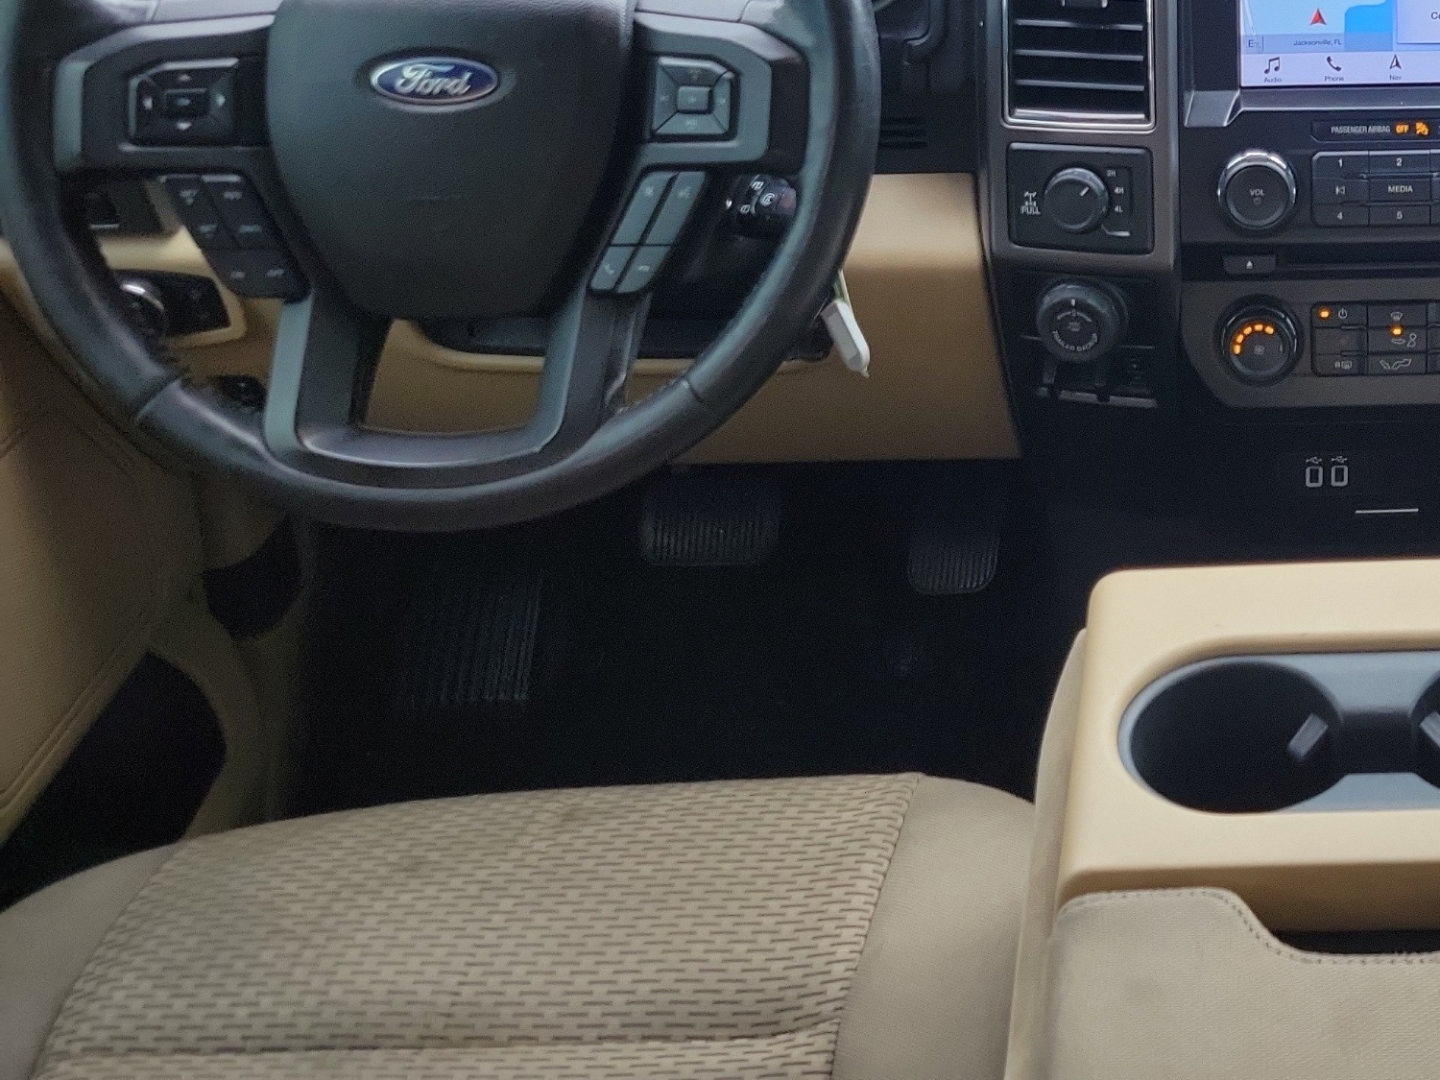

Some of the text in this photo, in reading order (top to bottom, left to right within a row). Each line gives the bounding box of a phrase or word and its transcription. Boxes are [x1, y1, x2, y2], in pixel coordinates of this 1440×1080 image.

[395, 63, 472, 95] Ford
[1395, 124, 1409, 133] OFF
[1396, 157, 1403, 167] 2
[1250, 188, 1265, 196] VOL
[1387, 184, 1413, 193] MEDIA
